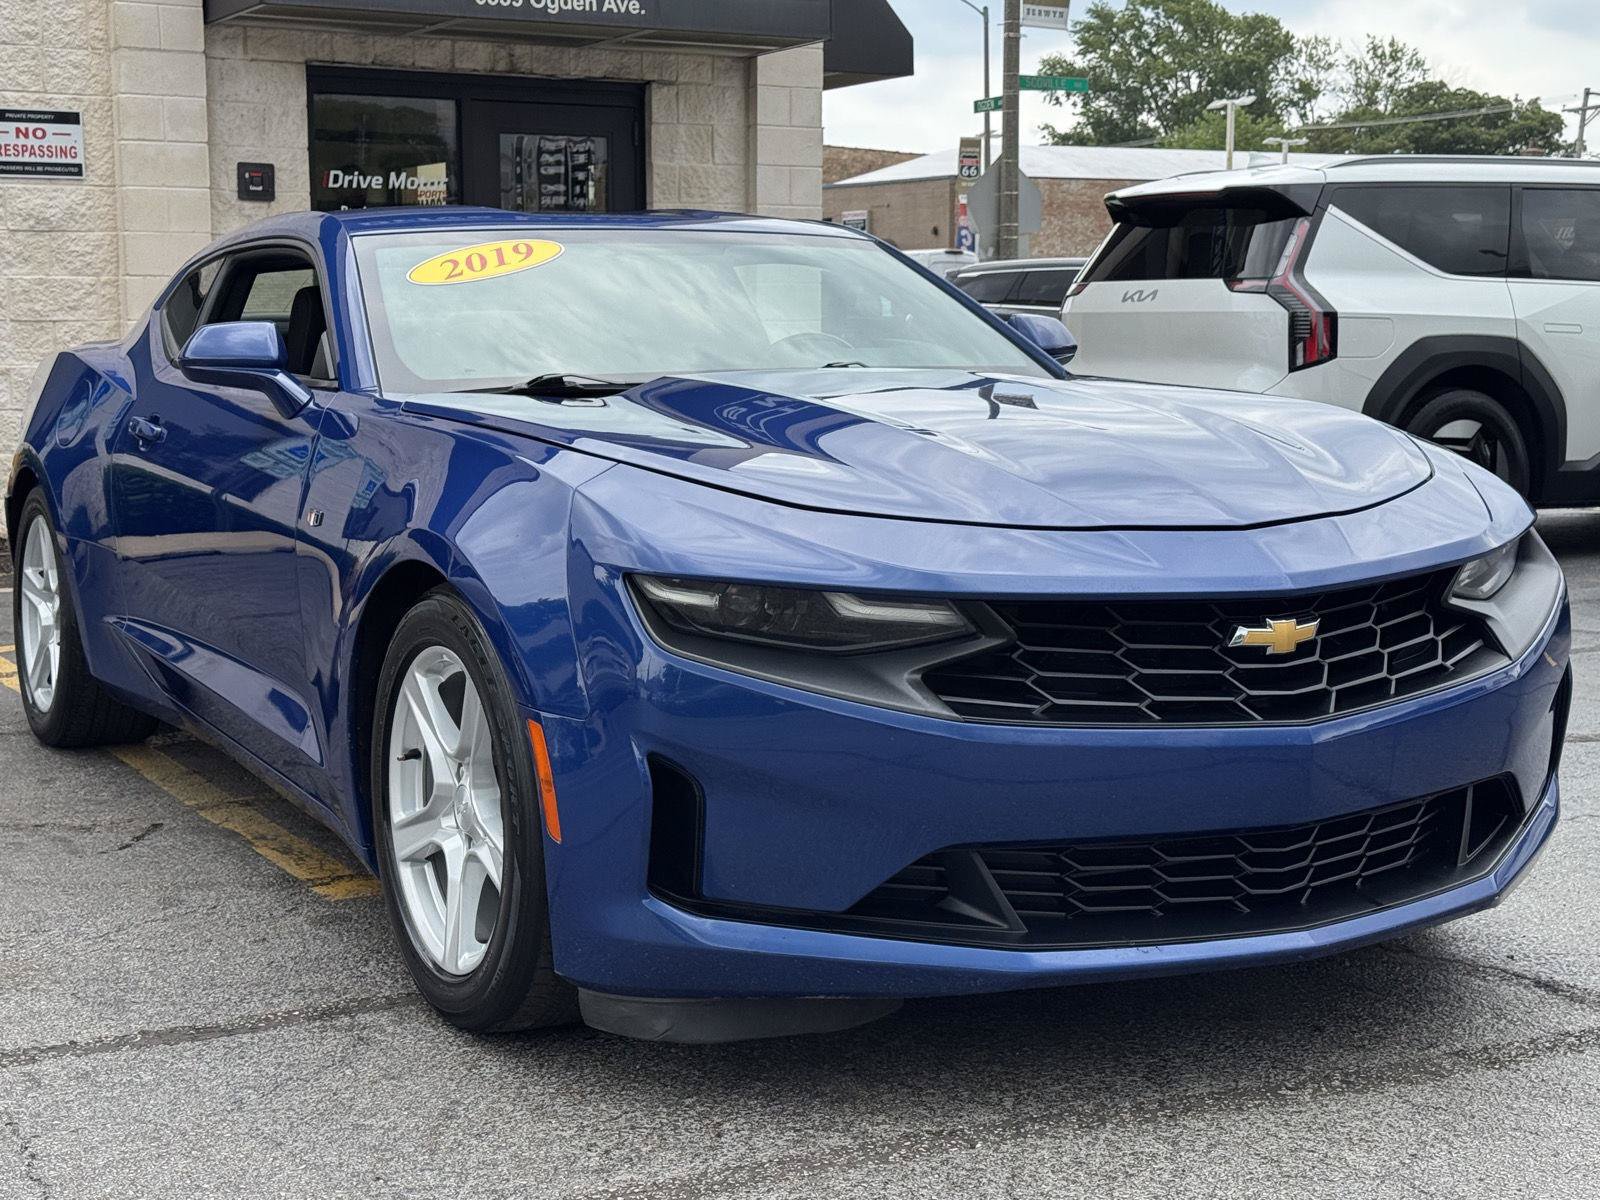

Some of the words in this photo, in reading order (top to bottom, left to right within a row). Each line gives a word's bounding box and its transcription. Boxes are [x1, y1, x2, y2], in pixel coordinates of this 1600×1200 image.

[530, 0, 597, 14] Ogden
[602, 0, 646, 15] Ave.
[15, 126, 47, 140] NO
[961, 166, 978, 177] 66
[439, 242, 534, 281] 2019
